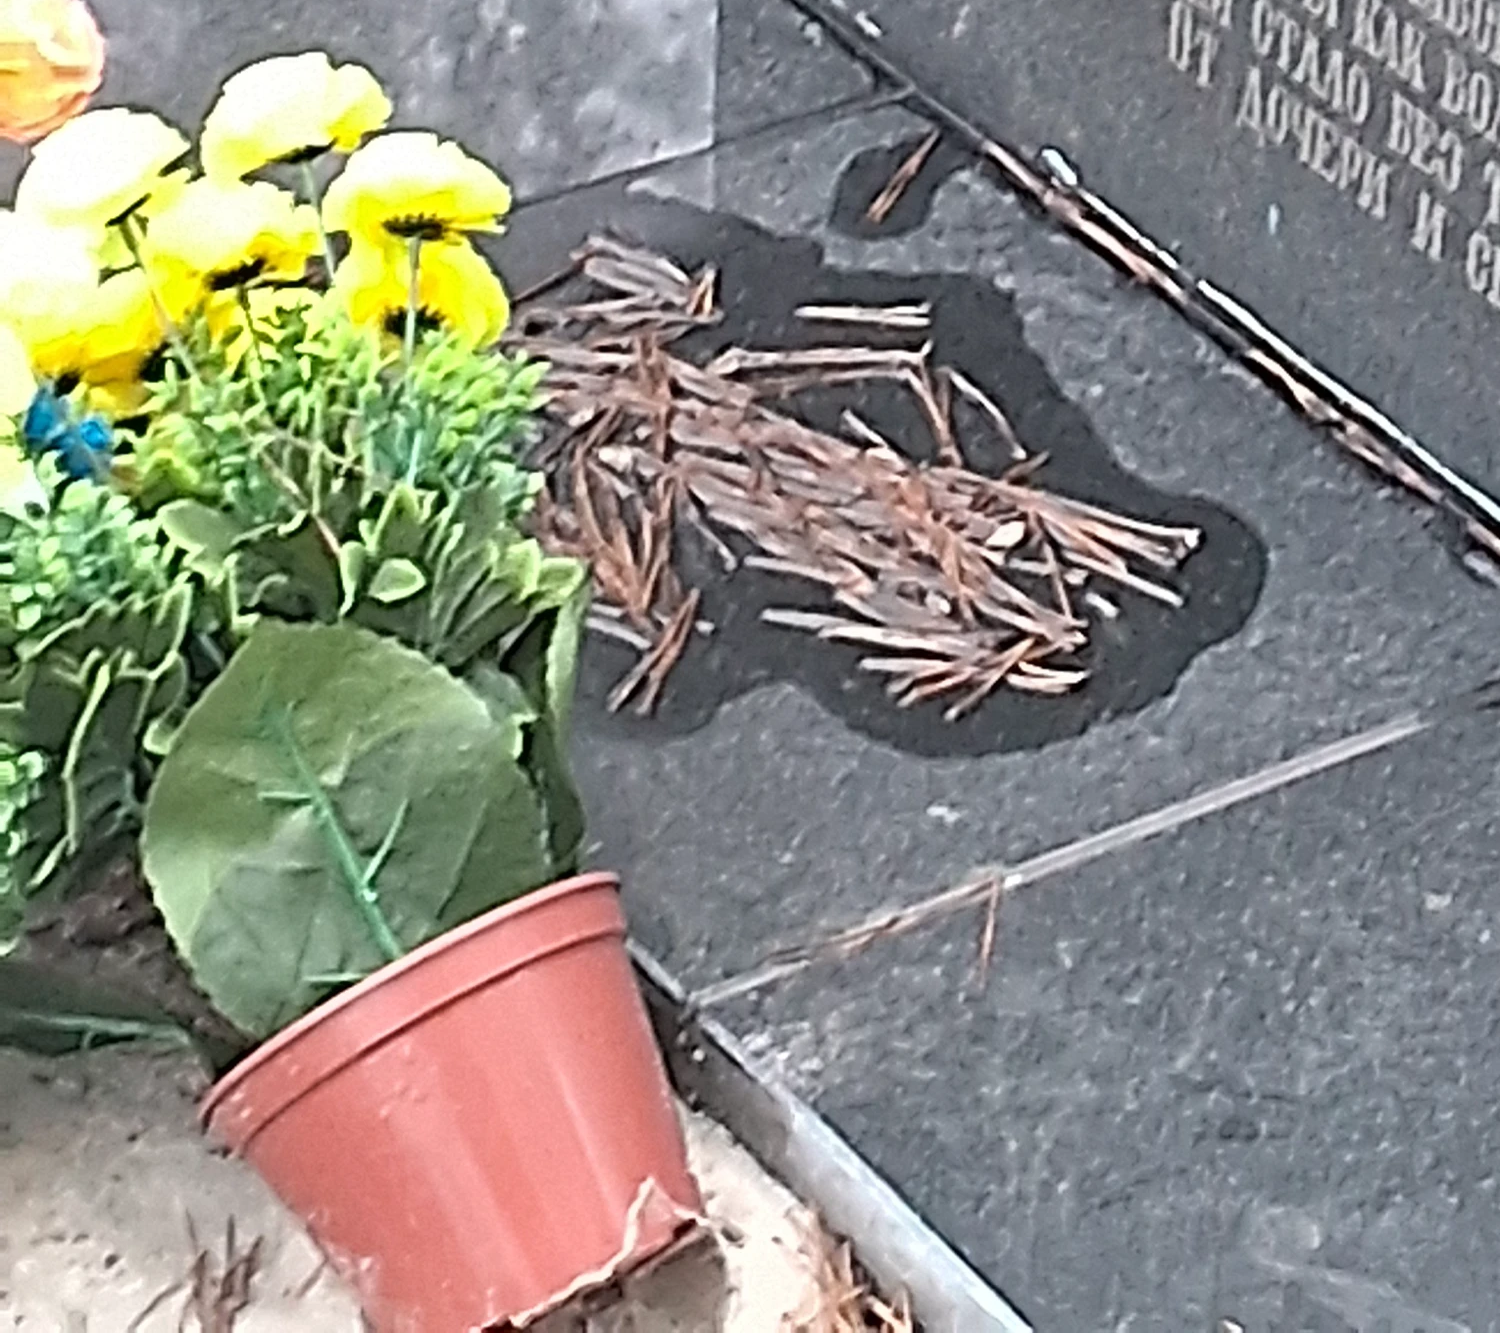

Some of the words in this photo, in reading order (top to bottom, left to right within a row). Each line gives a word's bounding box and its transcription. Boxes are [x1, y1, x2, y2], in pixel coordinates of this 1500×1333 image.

[1236, 65, 1391, 220] ДОЧЕРИ
[1412, 190, 1448, 261] И
[1388, 90, 1463, 193] БЕЗ
